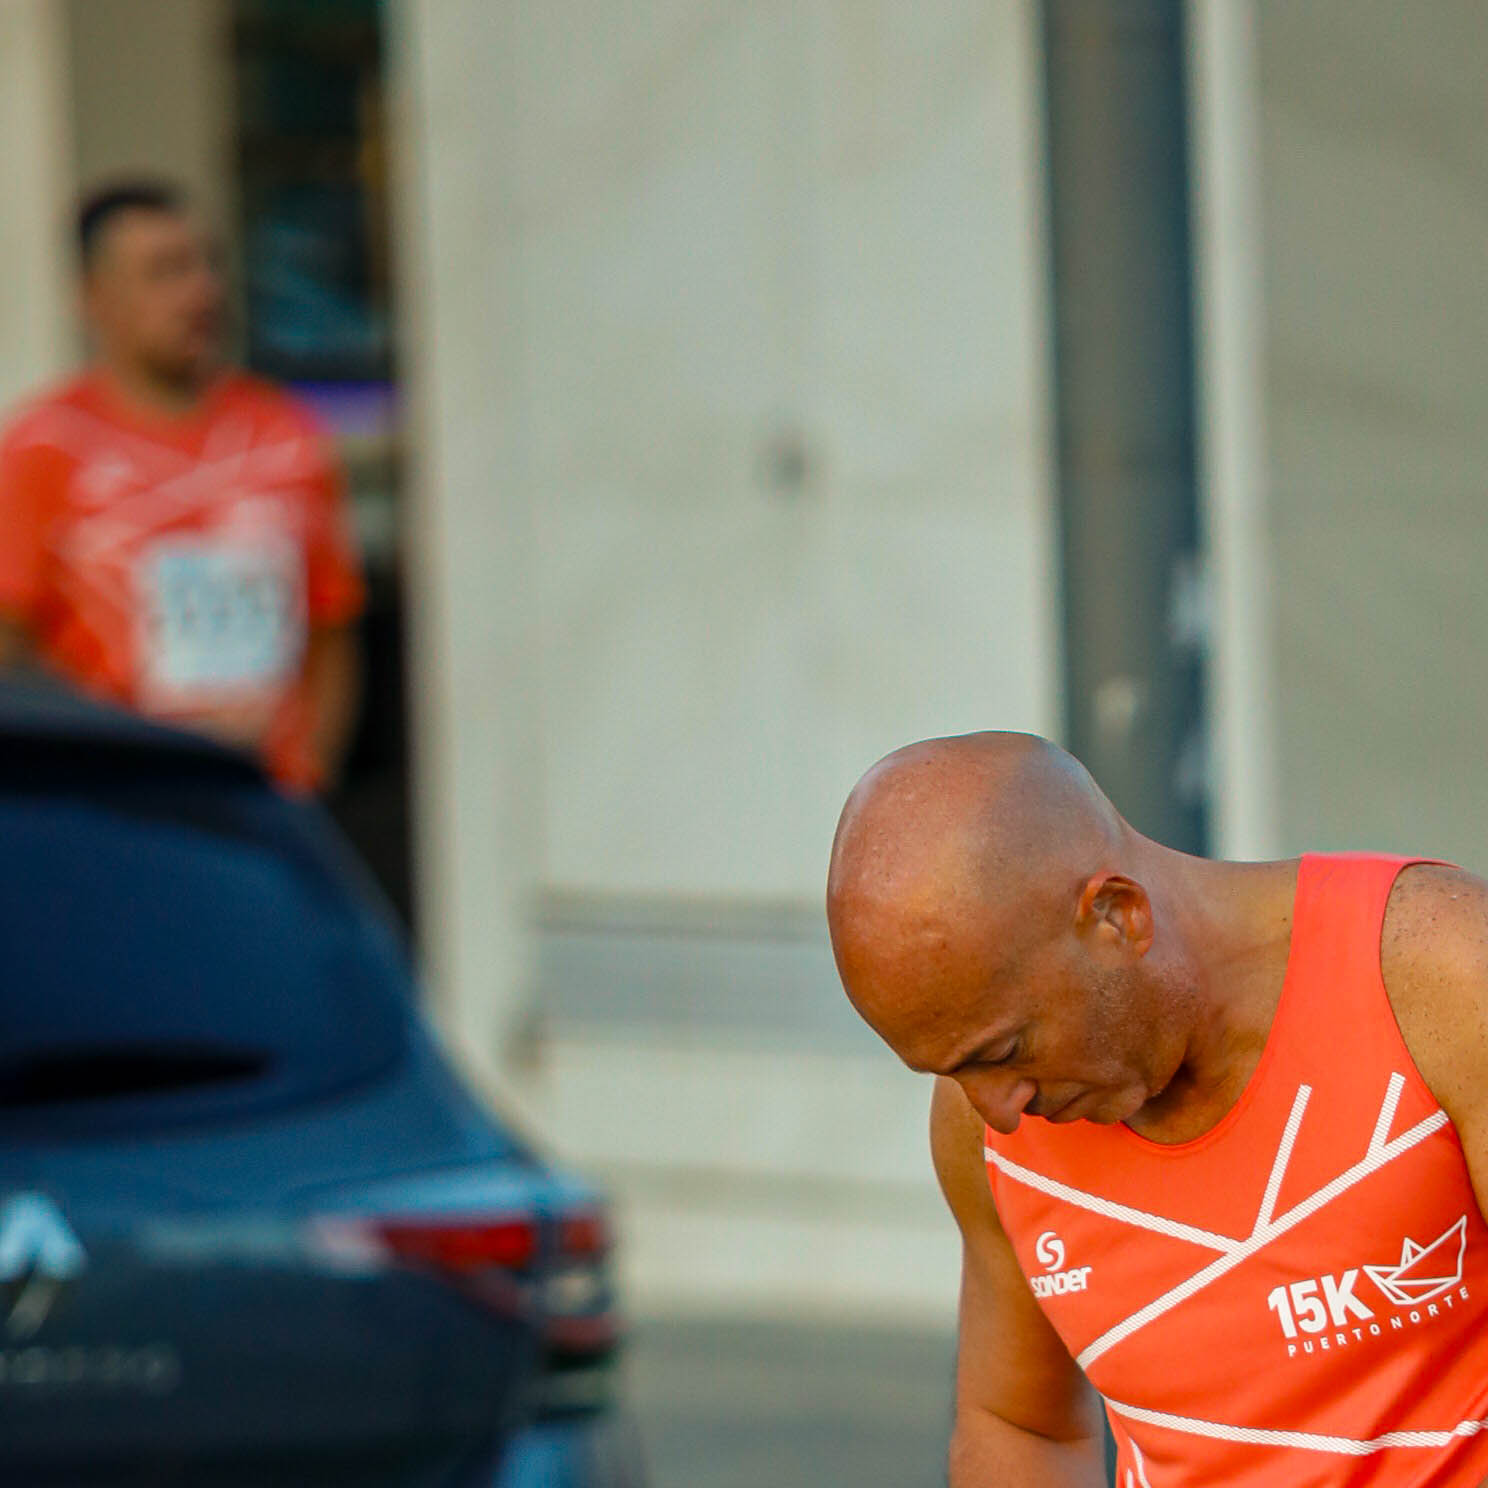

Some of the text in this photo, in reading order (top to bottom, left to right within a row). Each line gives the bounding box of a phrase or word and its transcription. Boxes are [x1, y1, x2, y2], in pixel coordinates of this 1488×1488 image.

[1268, 1269, 1375, 1338] 15K
[1288, 1286, 1469, 1357] PUERTO NORTE
